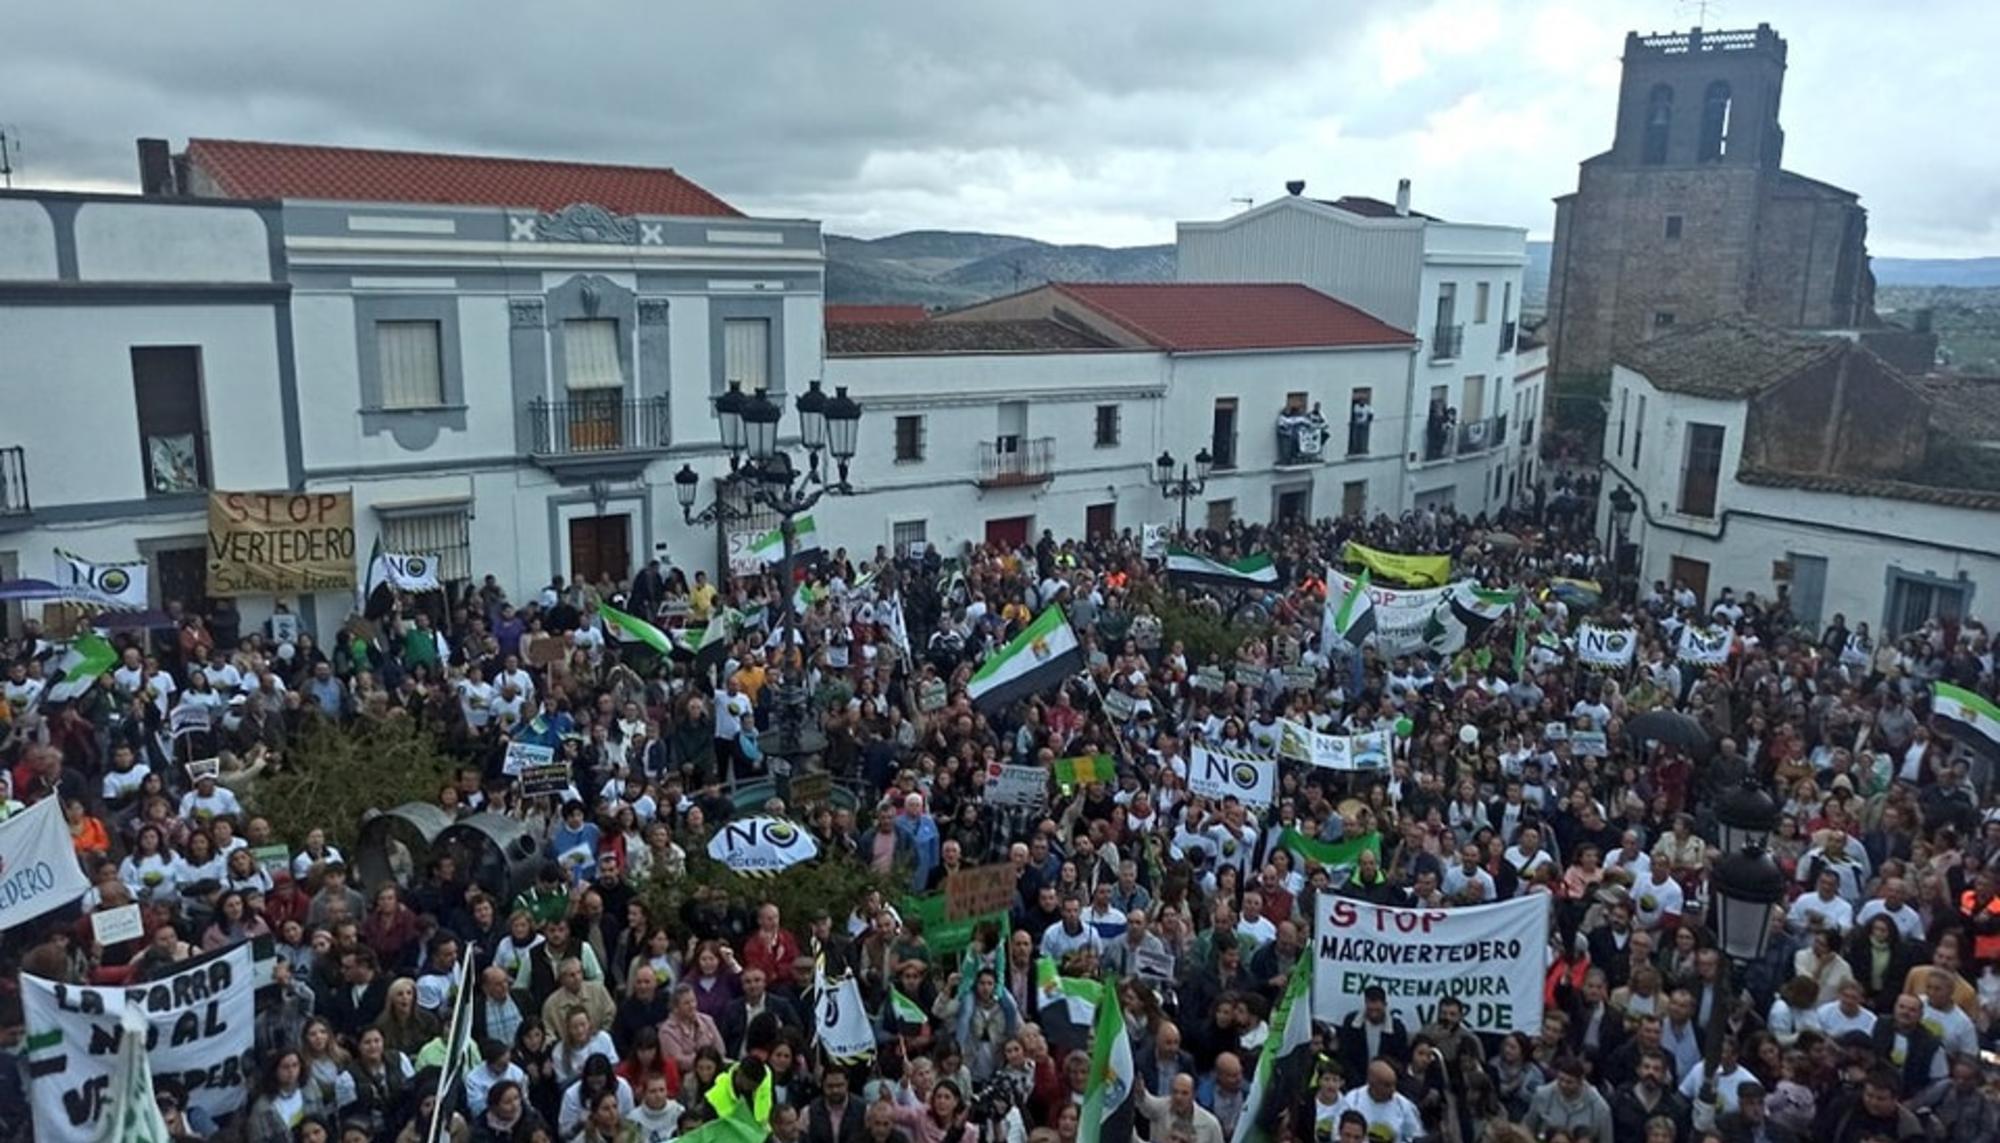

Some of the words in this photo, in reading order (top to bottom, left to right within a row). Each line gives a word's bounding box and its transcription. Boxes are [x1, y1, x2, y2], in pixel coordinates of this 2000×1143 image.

[227, 493, 336, 523] STOP
[208, 527, 355, 565] VERTEDERO
[70, 561, 130, 595] NO
[1344, 581, 1396, 606] SOP
[1587, 631, 1628, 653] NO
[1316, 738, 1344, 753] NO
[1205, 753, 1260, 791] NO
[725, 821, 799, 850] NO
[1329, 901, 1448, 933] STOP
[1320, 935, 1521, 965] MACROVERTEDERO
[53, 984, 105, 1015] LA
[1342, 971, 1510, 998] EXTREMADURA
[171, 1000, 228, 1047] AL
[1416, 1003, 1513, 1031] VRDE
